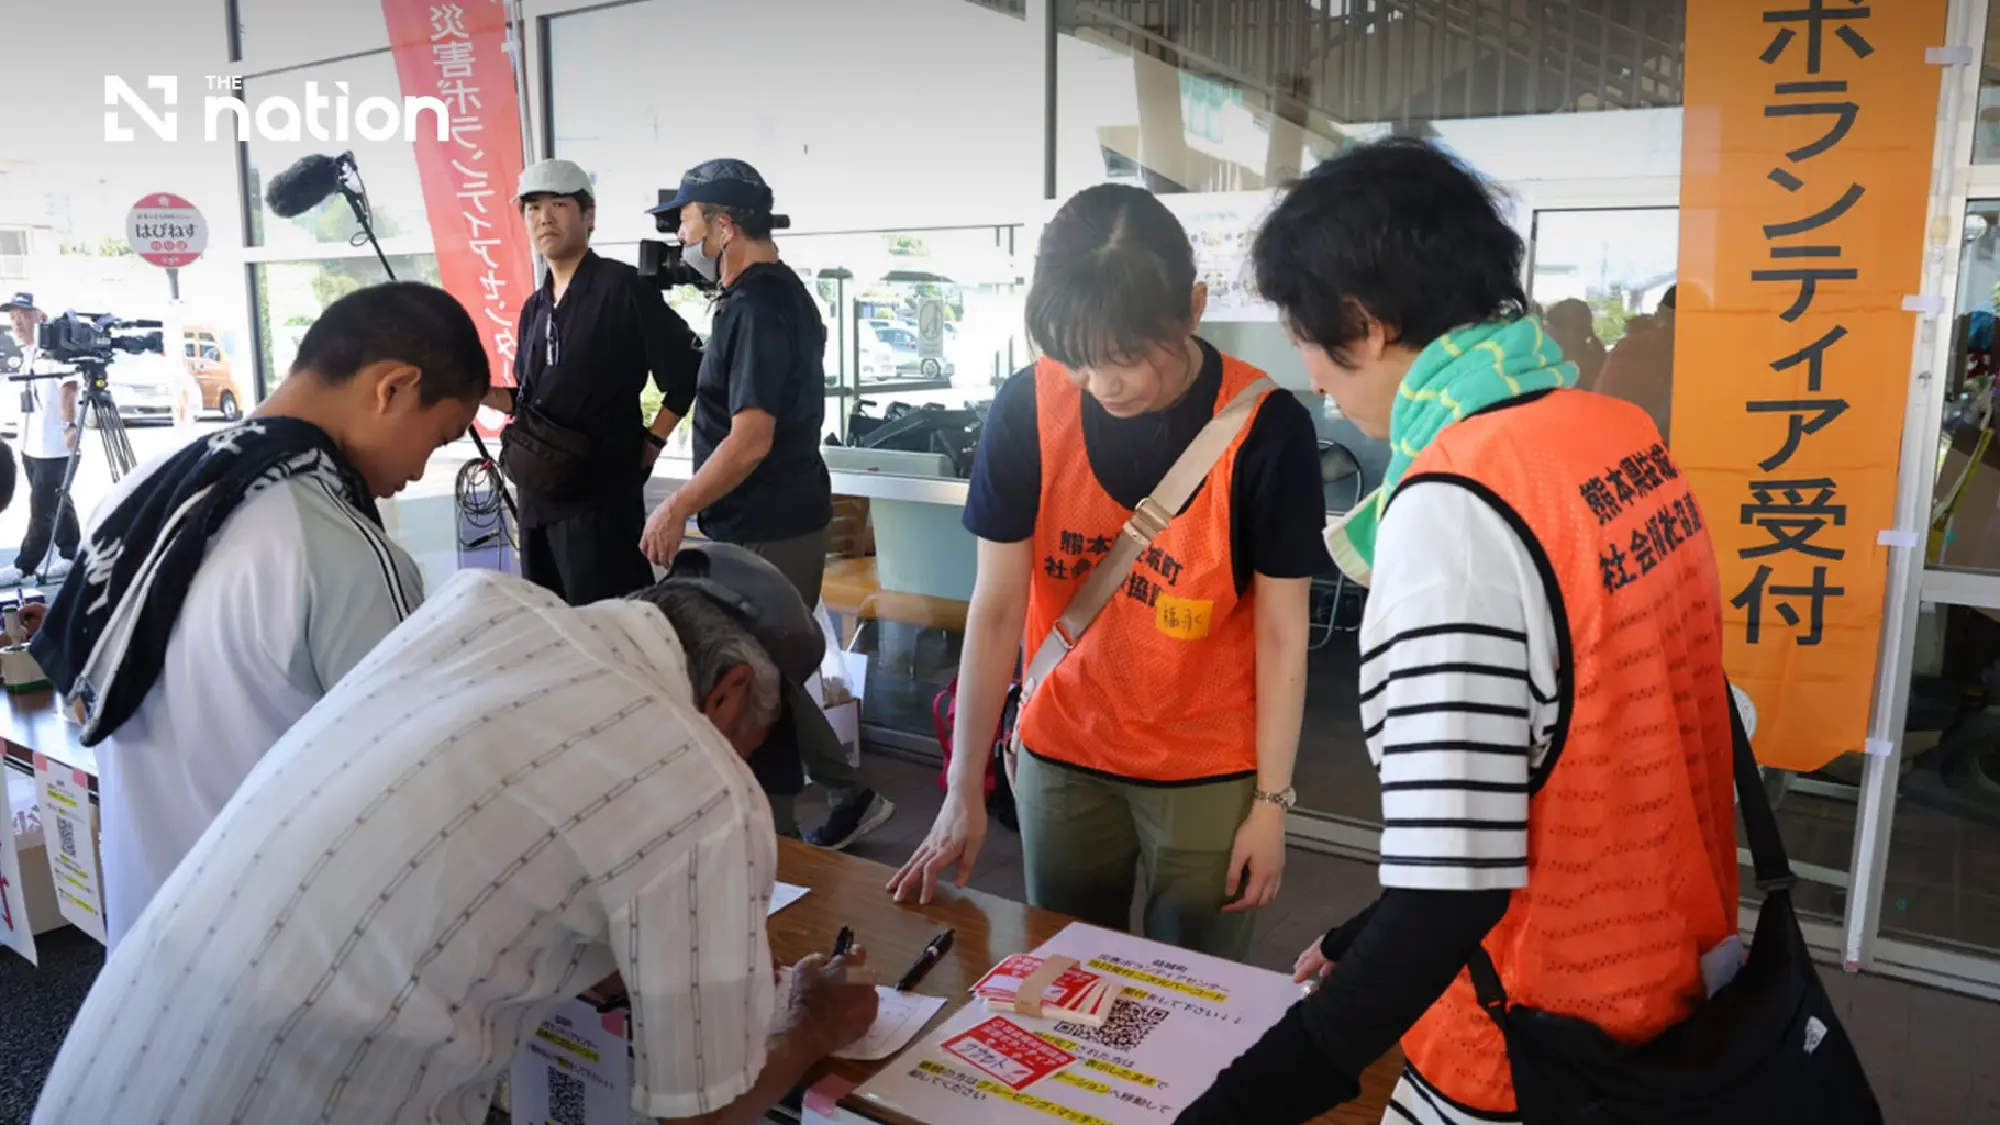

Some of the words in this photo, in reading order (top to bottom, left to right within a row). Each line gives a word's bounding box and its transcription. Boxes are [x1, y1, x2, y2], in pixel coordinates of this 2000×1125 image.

[1730, 0, 1874, 646] ボランティア受付
